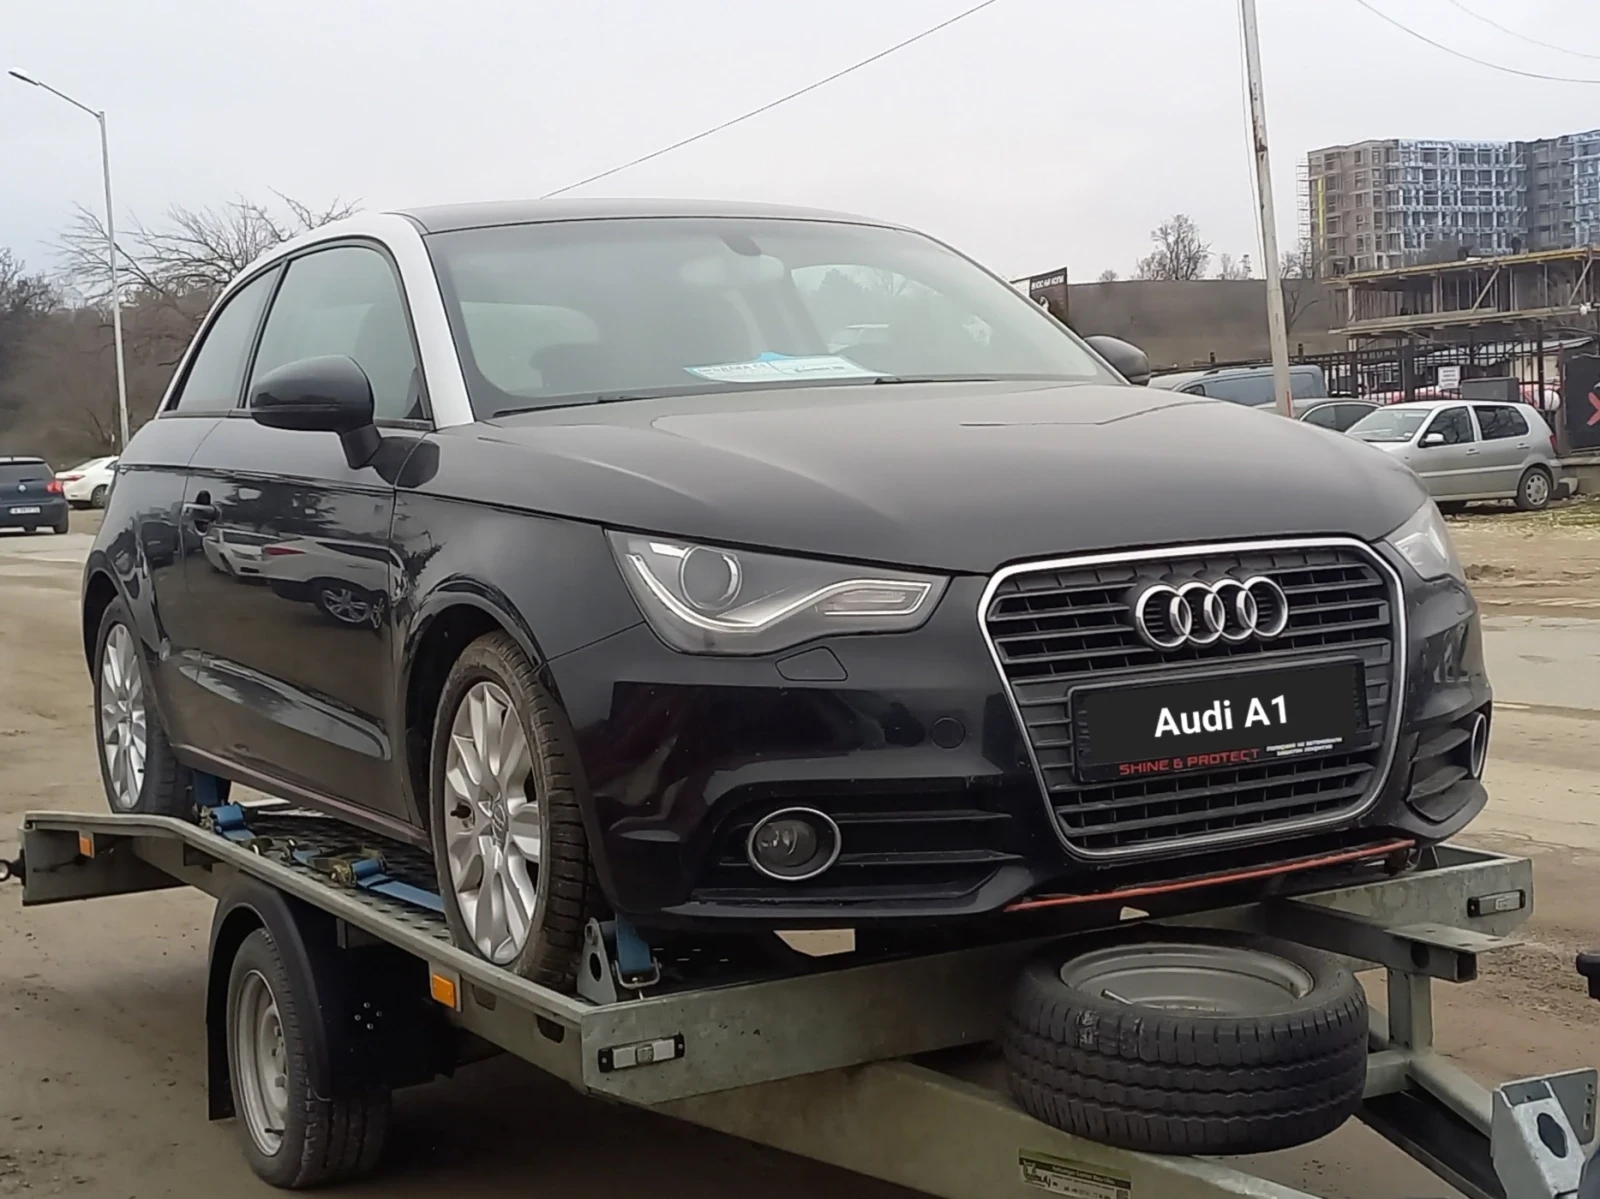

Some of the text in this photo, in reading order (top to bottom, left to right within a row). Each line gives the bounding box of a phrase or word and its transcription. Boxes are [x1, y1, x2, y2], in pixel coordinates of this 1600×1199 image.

[1119, 759, 1170, 775] SHINE
[1173, 757, 1183, 769] &
[1187, 748, 1260, 767] PROTECT
